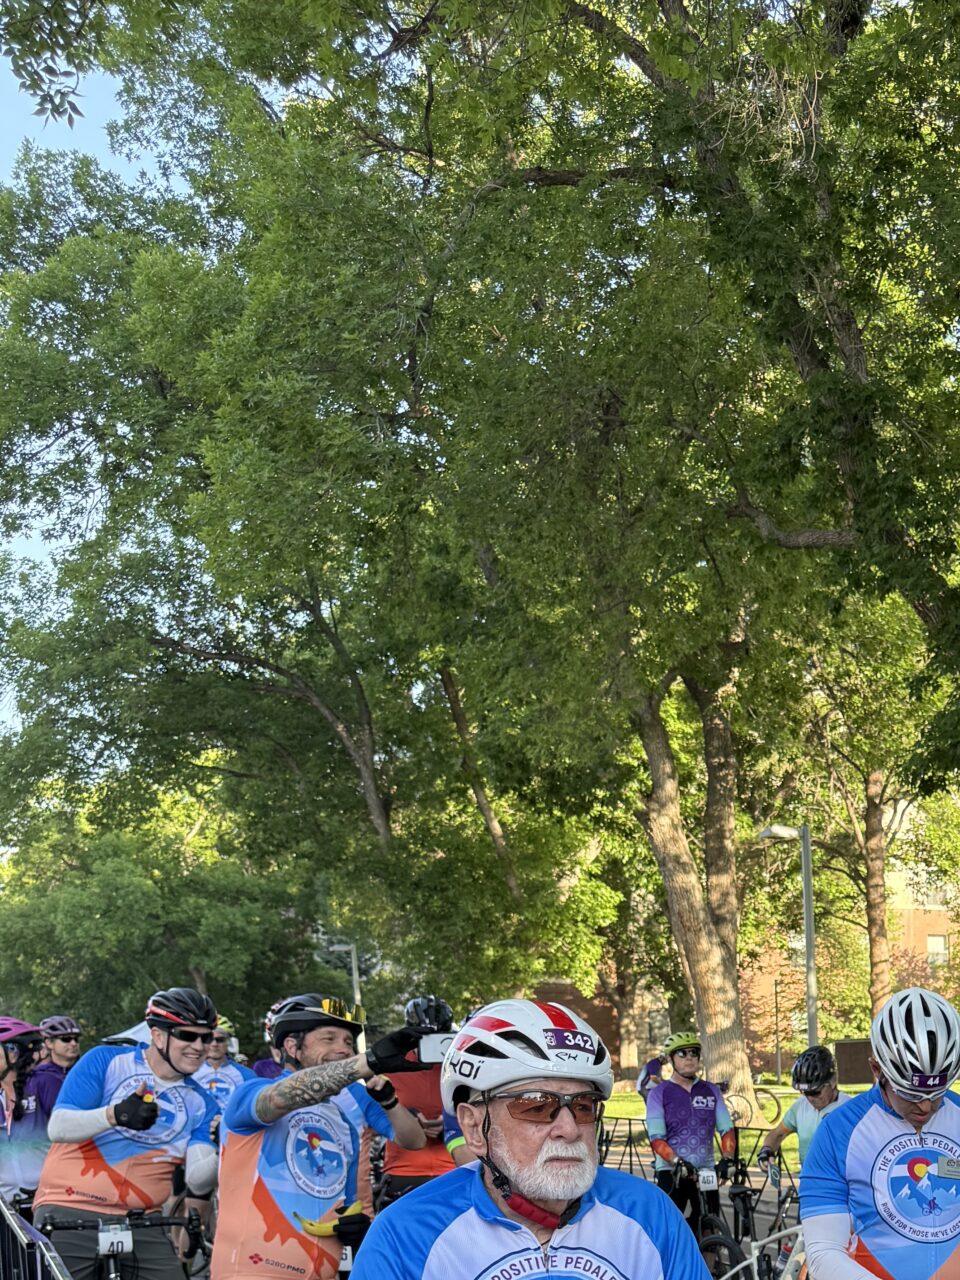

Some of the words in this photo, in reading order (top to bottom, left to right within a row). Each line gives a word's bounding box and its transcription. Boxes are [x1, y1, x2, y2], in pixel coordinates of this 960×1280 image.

[563, 1032, 594, 1050] 342
[926, 1076, 940, 1086] 44
[878, 1156, 893, 1172] THE
[889, 1137, 929, 1157] POSITIVE
[881, 1202, 896, 1221] RIDING
[895, 1219, 908, 1230] FOR
[908, 1227, 929, 1238] THOSE
[930, 1228, 948, 1238] WE'VE
[108, 1241, 124, 1254] 40
[286, 1265, 306, 1274] PMO
